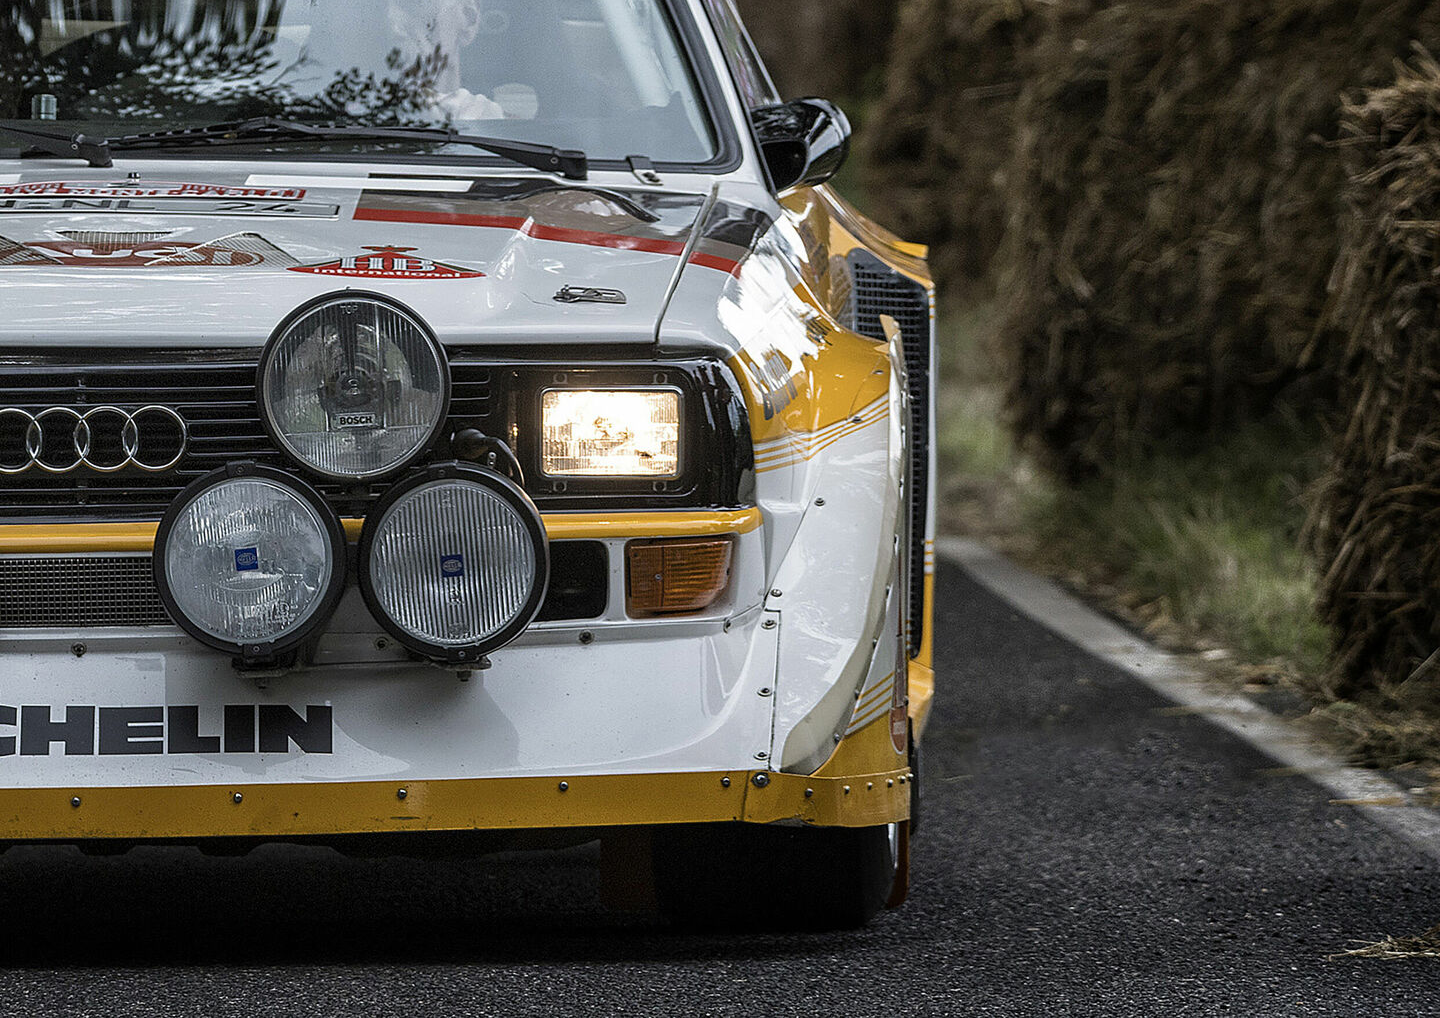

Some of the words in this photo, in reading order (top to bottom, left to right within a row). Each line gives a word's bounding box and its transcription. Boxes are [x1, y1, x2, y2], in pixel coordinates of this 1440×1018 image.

[340, 257, 436, 271] HB
[314, 268, 461, 278] International
[339, 305, 359, 315] TOP
[339, 416, 373, 425] BOSCH
